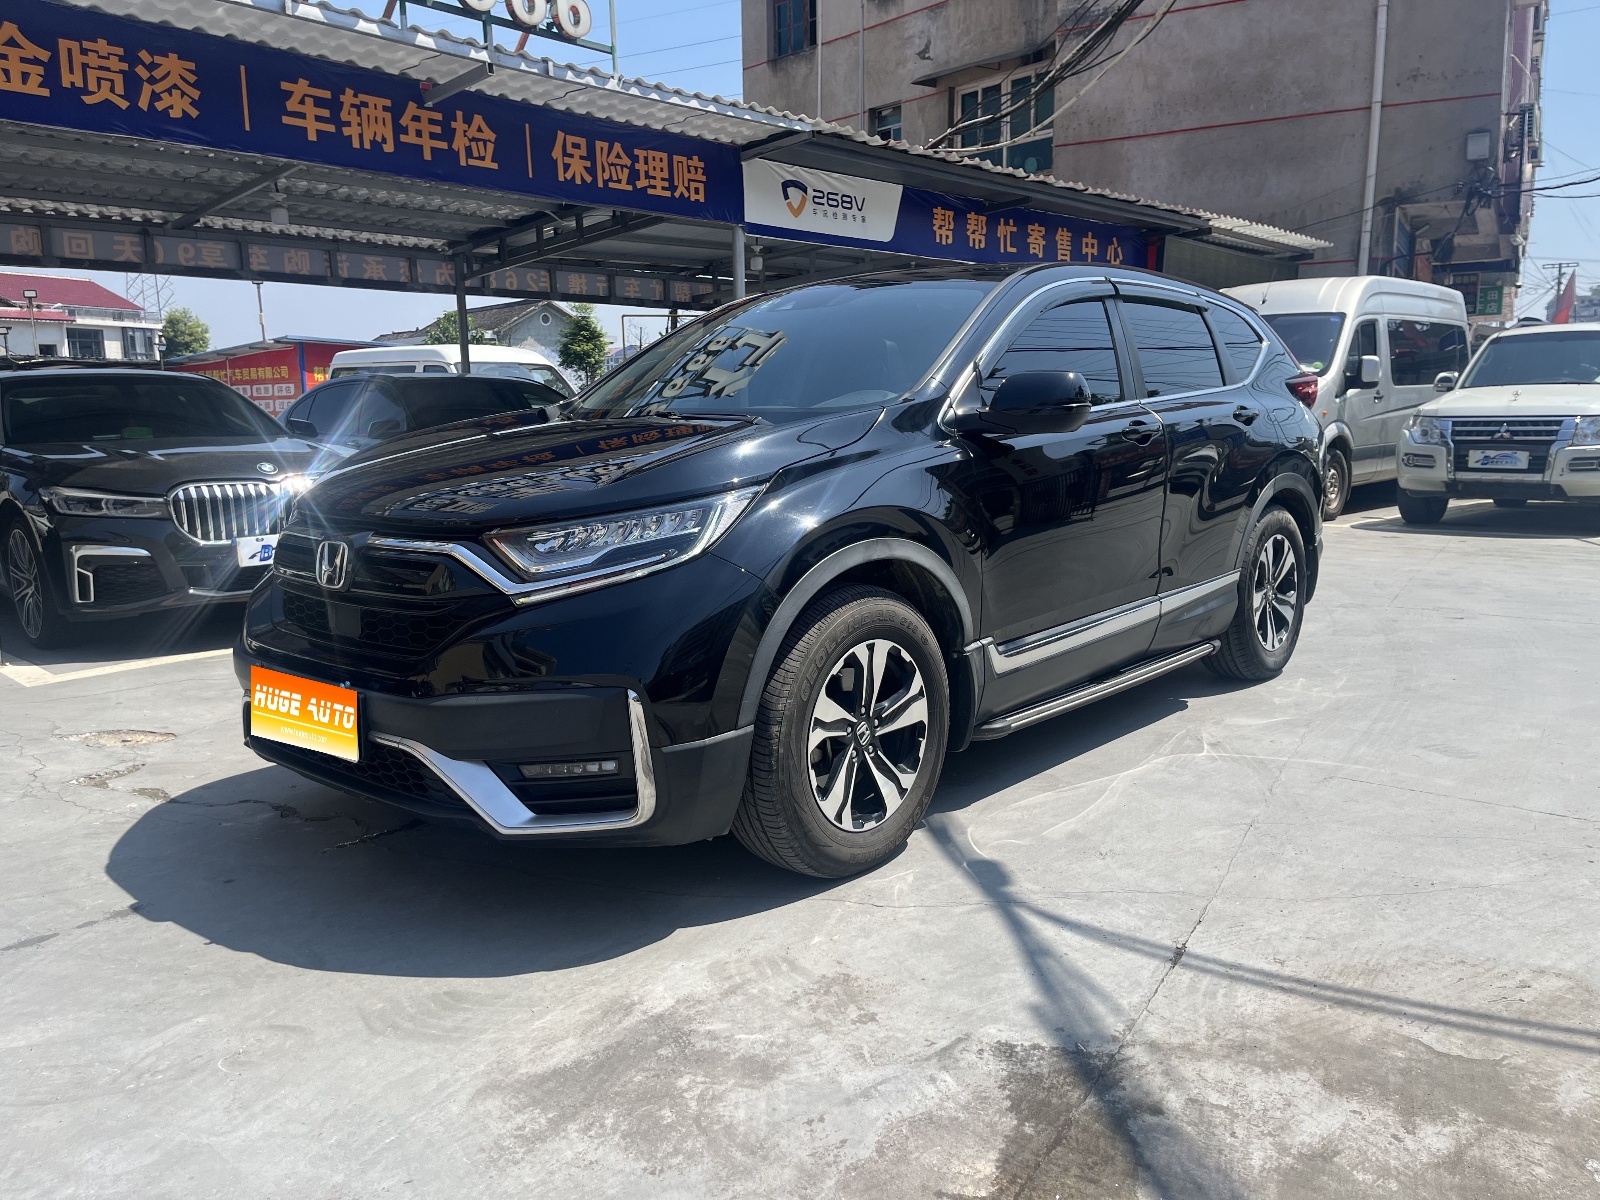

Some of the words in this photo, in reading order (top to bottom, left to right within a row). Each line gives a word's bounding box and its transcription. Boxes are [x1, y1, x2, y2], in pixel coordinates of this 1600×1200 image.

[0, 21, 201, 120] 金喷漆
[279, 77, 499, 171] 车辆年检
[551, 130, 707, 203] 保险理赔
[811, 188, 866, 212] 268V
[931, 205, 1124, 266] 帮帮忙寄售中心
[800, 609, 897, 702] GEOLANDAR
